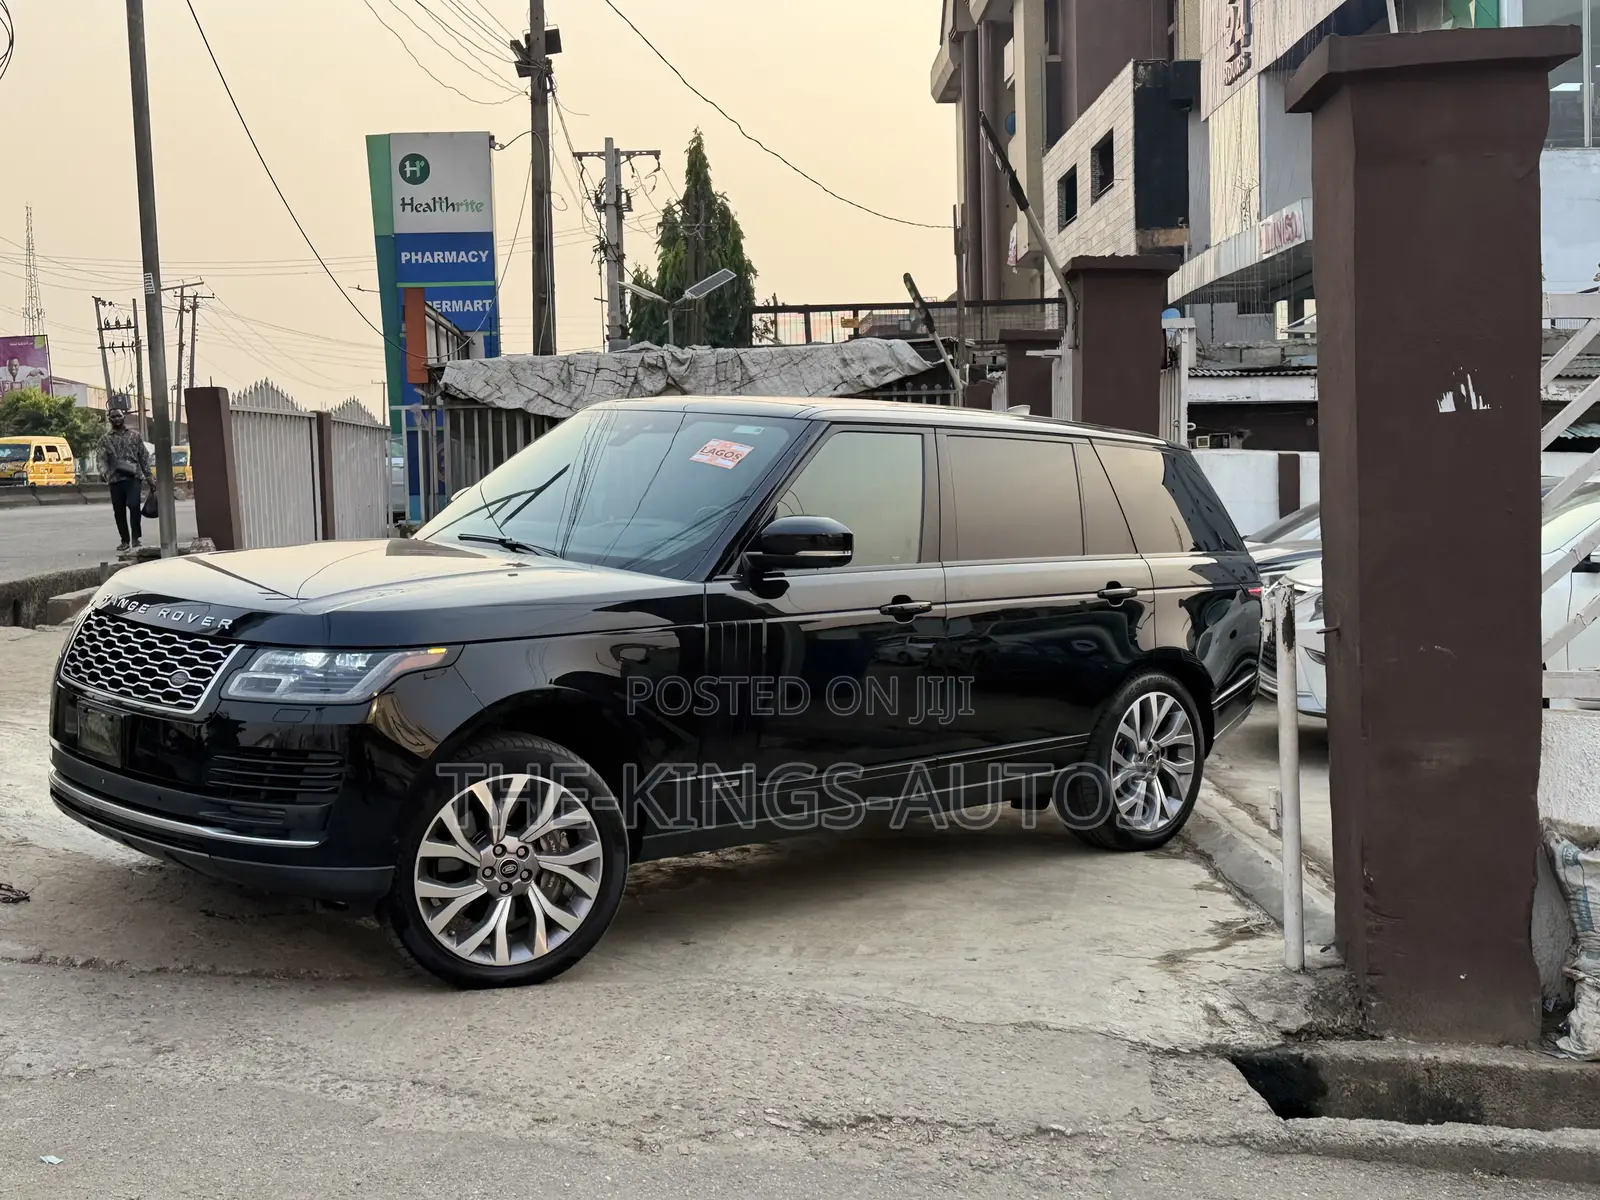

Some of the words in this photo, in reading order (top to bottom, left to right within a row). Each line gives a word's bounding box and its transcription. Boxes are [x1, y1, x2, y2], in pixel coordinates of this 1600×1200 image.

[400, 196, 484, 213] Healthrite
[401, 250, 489, 264] PHARMACY
[700, 446, 742, 460] LAGOS
[103, 593, 150, 614] RANGE
[158, 608, 233, 630] ROVER
